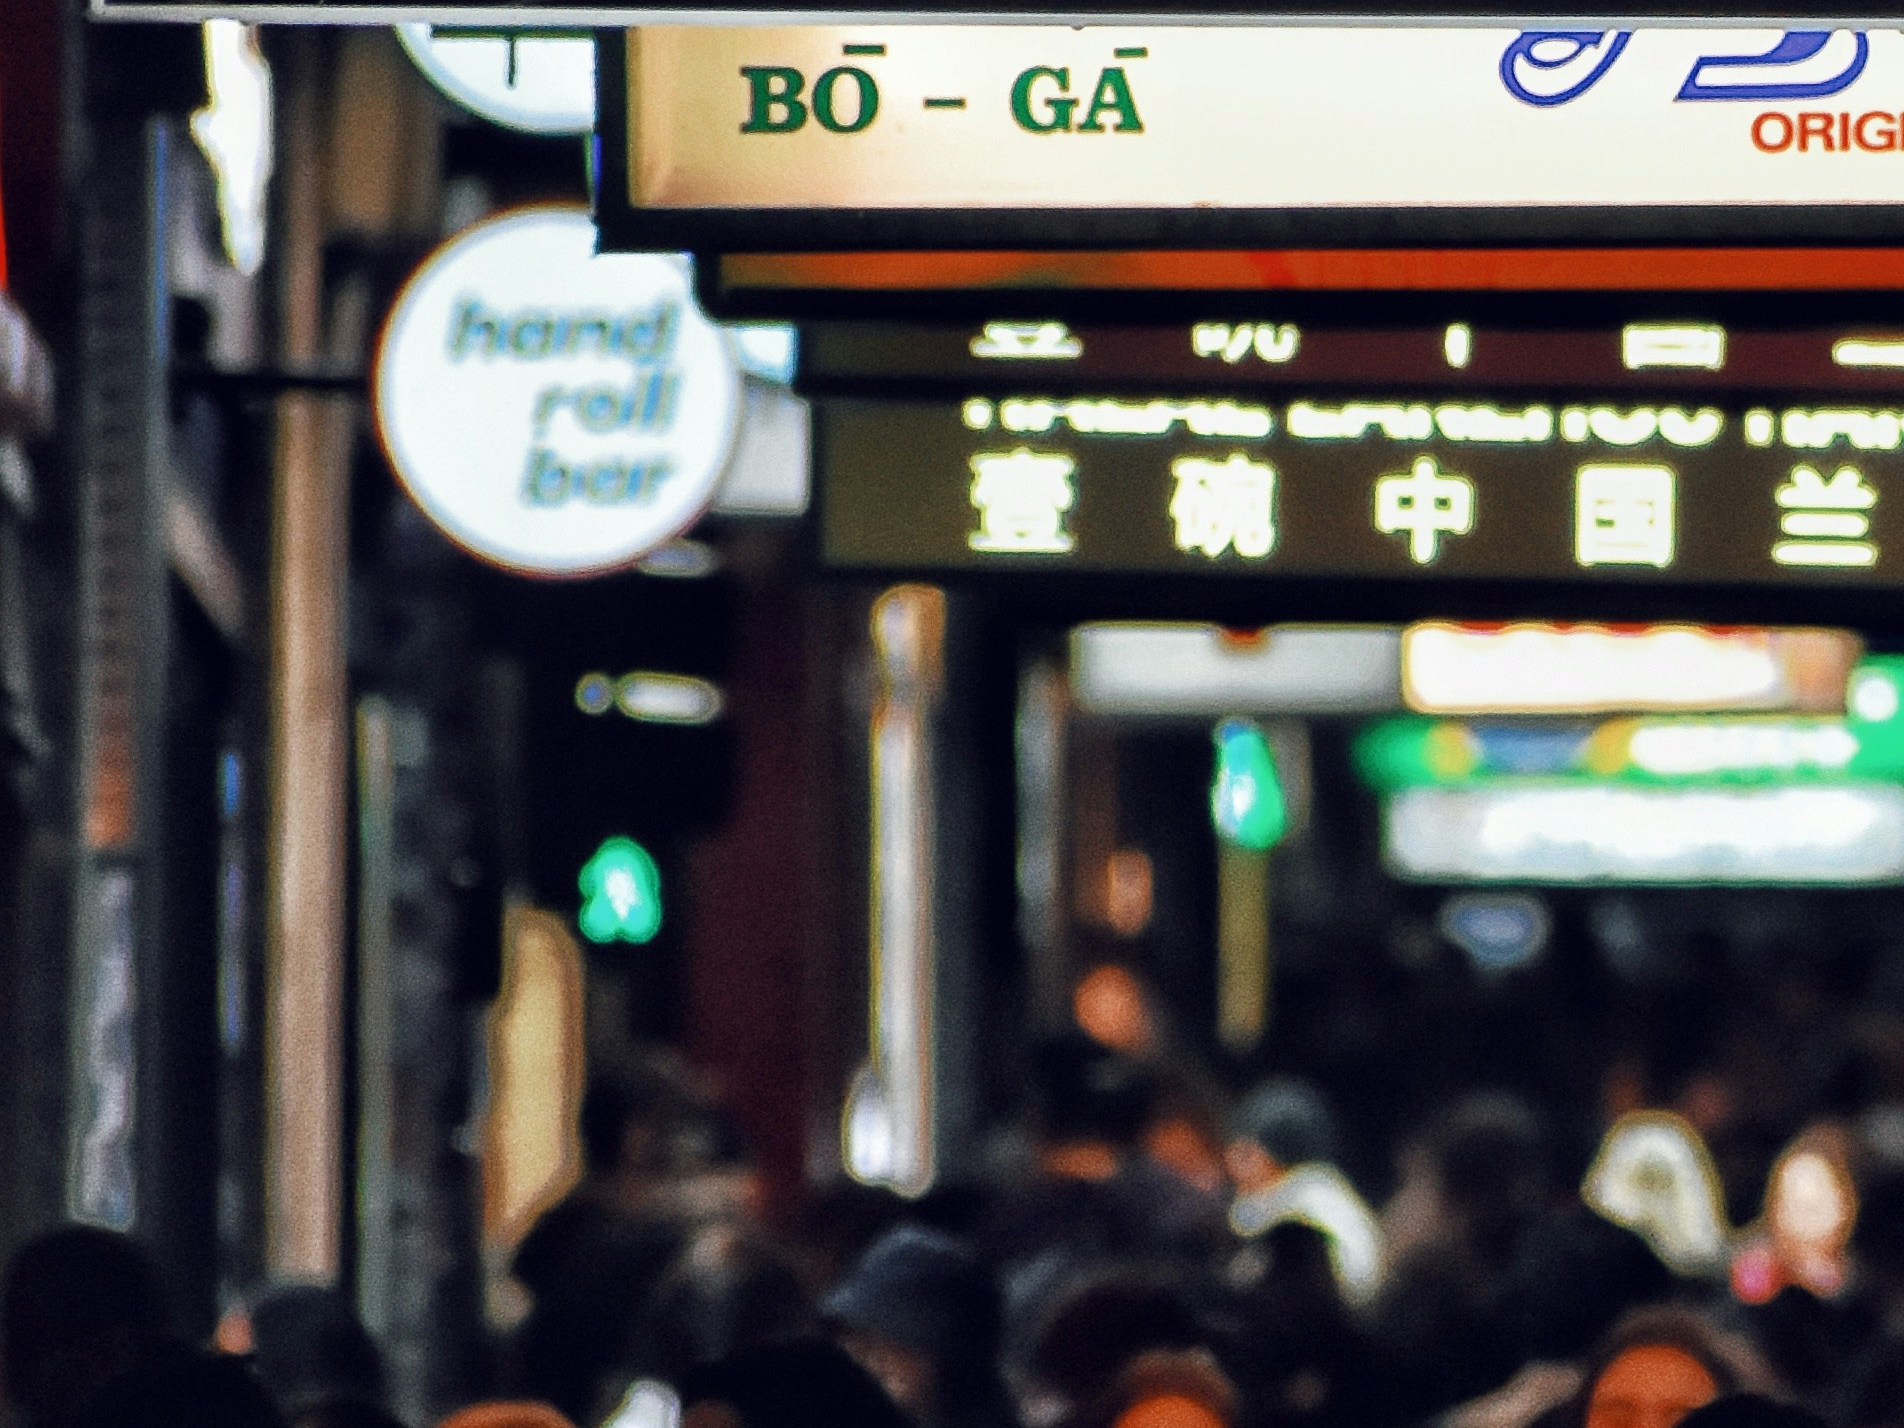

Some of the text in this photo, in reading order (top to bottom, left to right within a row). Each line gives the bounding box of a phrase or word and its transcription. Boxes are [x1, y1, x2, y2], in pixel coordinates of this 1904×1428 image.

[447, 295, 683, 362] hand
[533, 370, 681, 435] roll
[520, 445, 676, 508] bar
